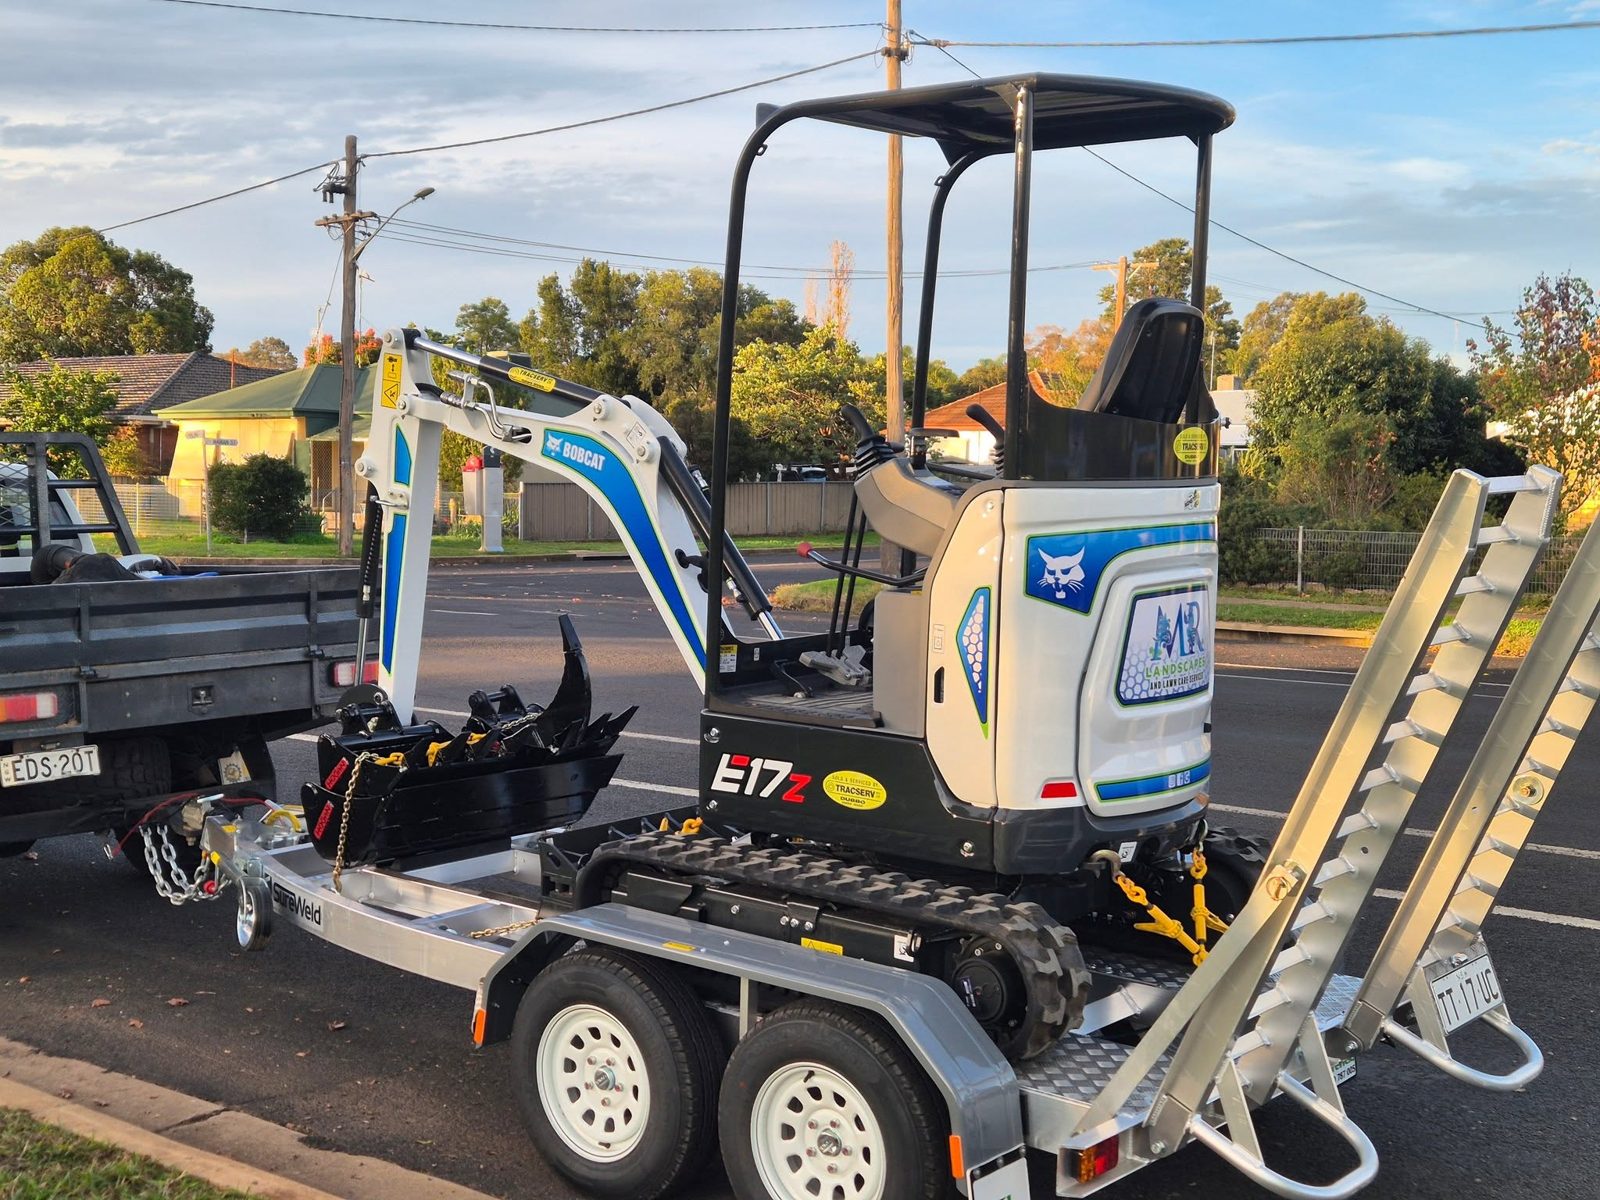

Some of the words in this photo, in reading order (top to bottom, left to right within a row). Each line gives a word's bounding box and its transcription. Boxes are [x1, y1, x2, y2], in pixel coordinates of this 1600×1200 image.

[519, 370, 548, 382] TRACSERV
[563, 442, 605, 471] BOBCAT
[1146, 656, 1205, 677] LANDSCAPES
[1150, 681, 1161, 690] AND
[1163, 678, 1177, 688] LAWN
[1178, 677, 1187, 686] CARE
[836, 784, 875, 798] TRACSERV
[840, 796, 866, 804] DUBBO
[273, 882, 322, 926] SureWeld
